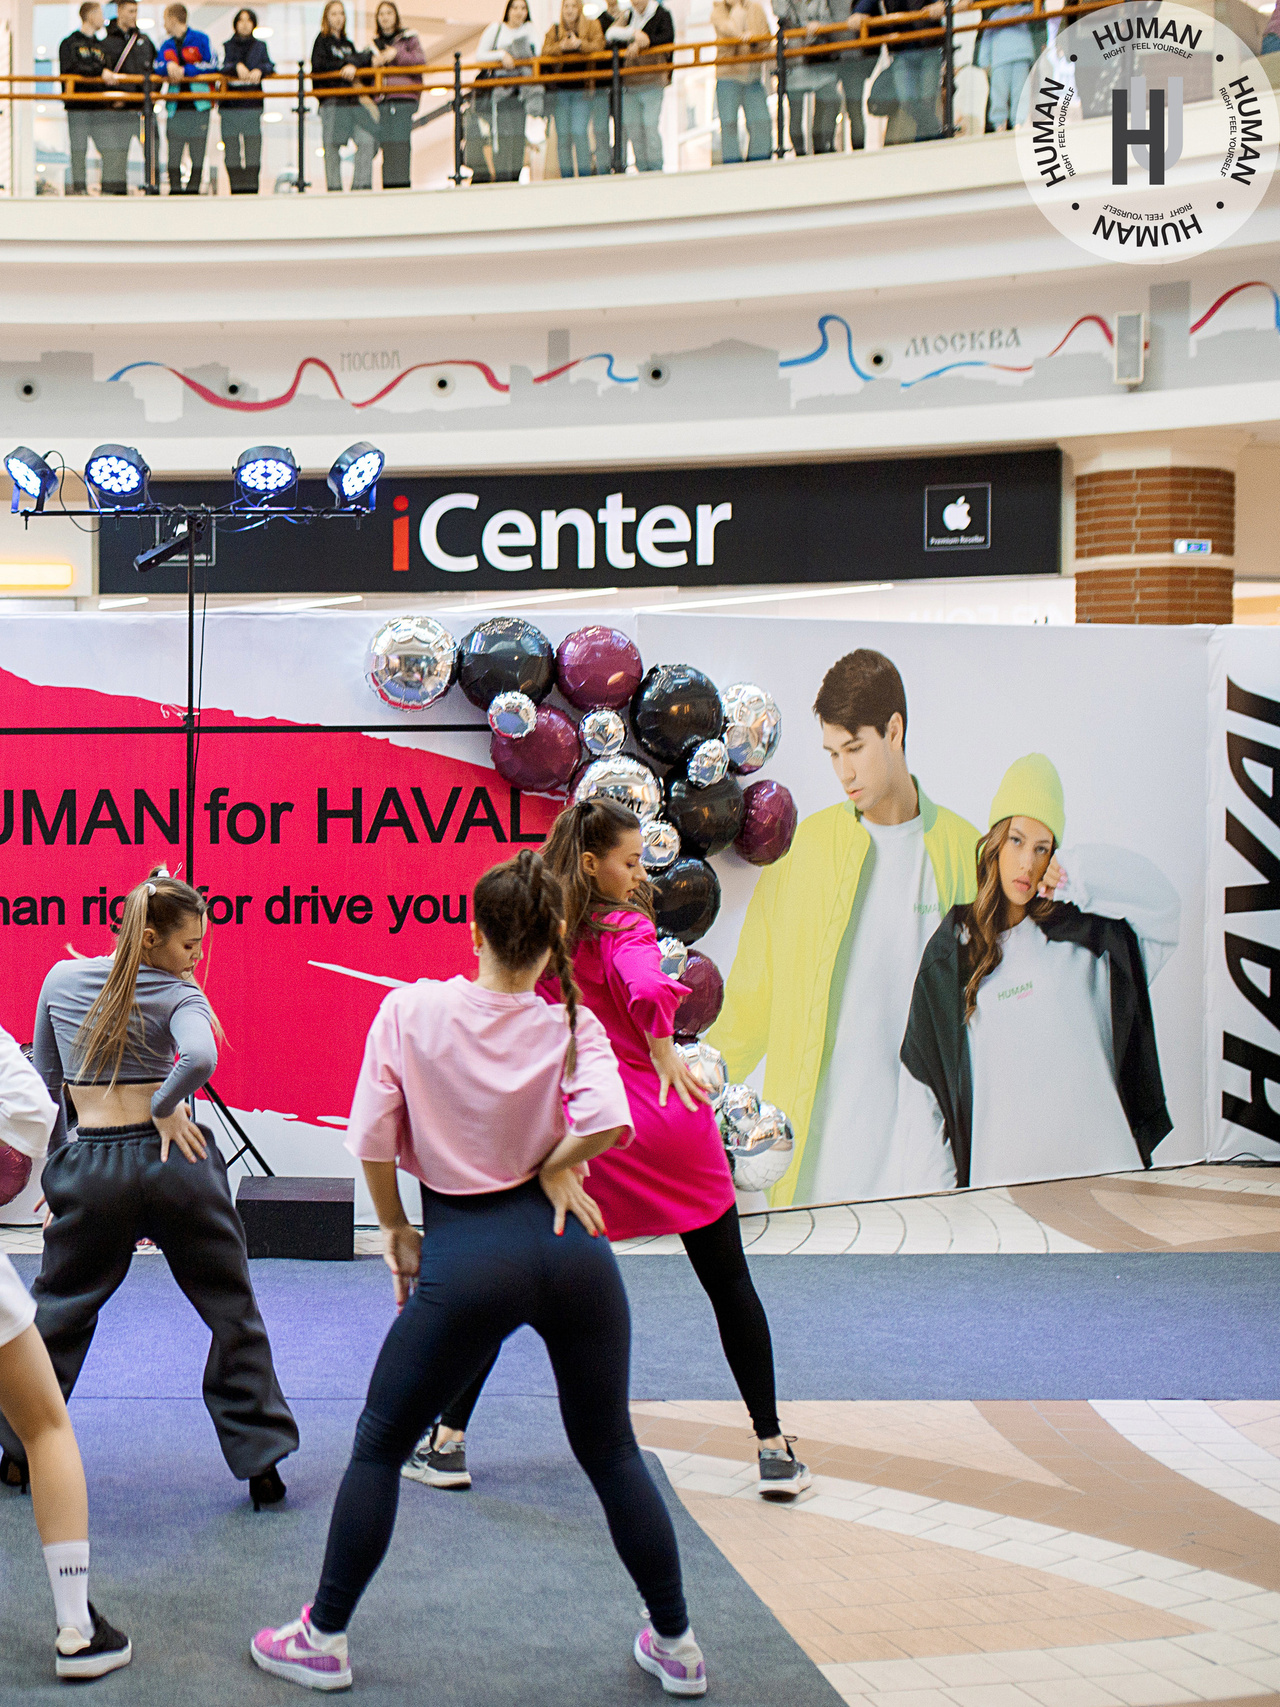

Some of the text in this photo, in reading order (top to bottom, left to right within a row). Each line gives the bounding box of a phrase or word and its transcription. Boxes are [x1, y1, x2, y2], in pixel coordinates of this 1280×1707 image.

[905, 327, 1021, 357] МОСКВА
[340, 350, 401, 372] МОСКВА
[393, 492, 732, 572] iCenter
[204, 787, 294, 845] for
[317, 786, 547, 844] HAVAL
[265, 886, 373, 925] drive
[998, 981, 1033, 1001] HUMAN
